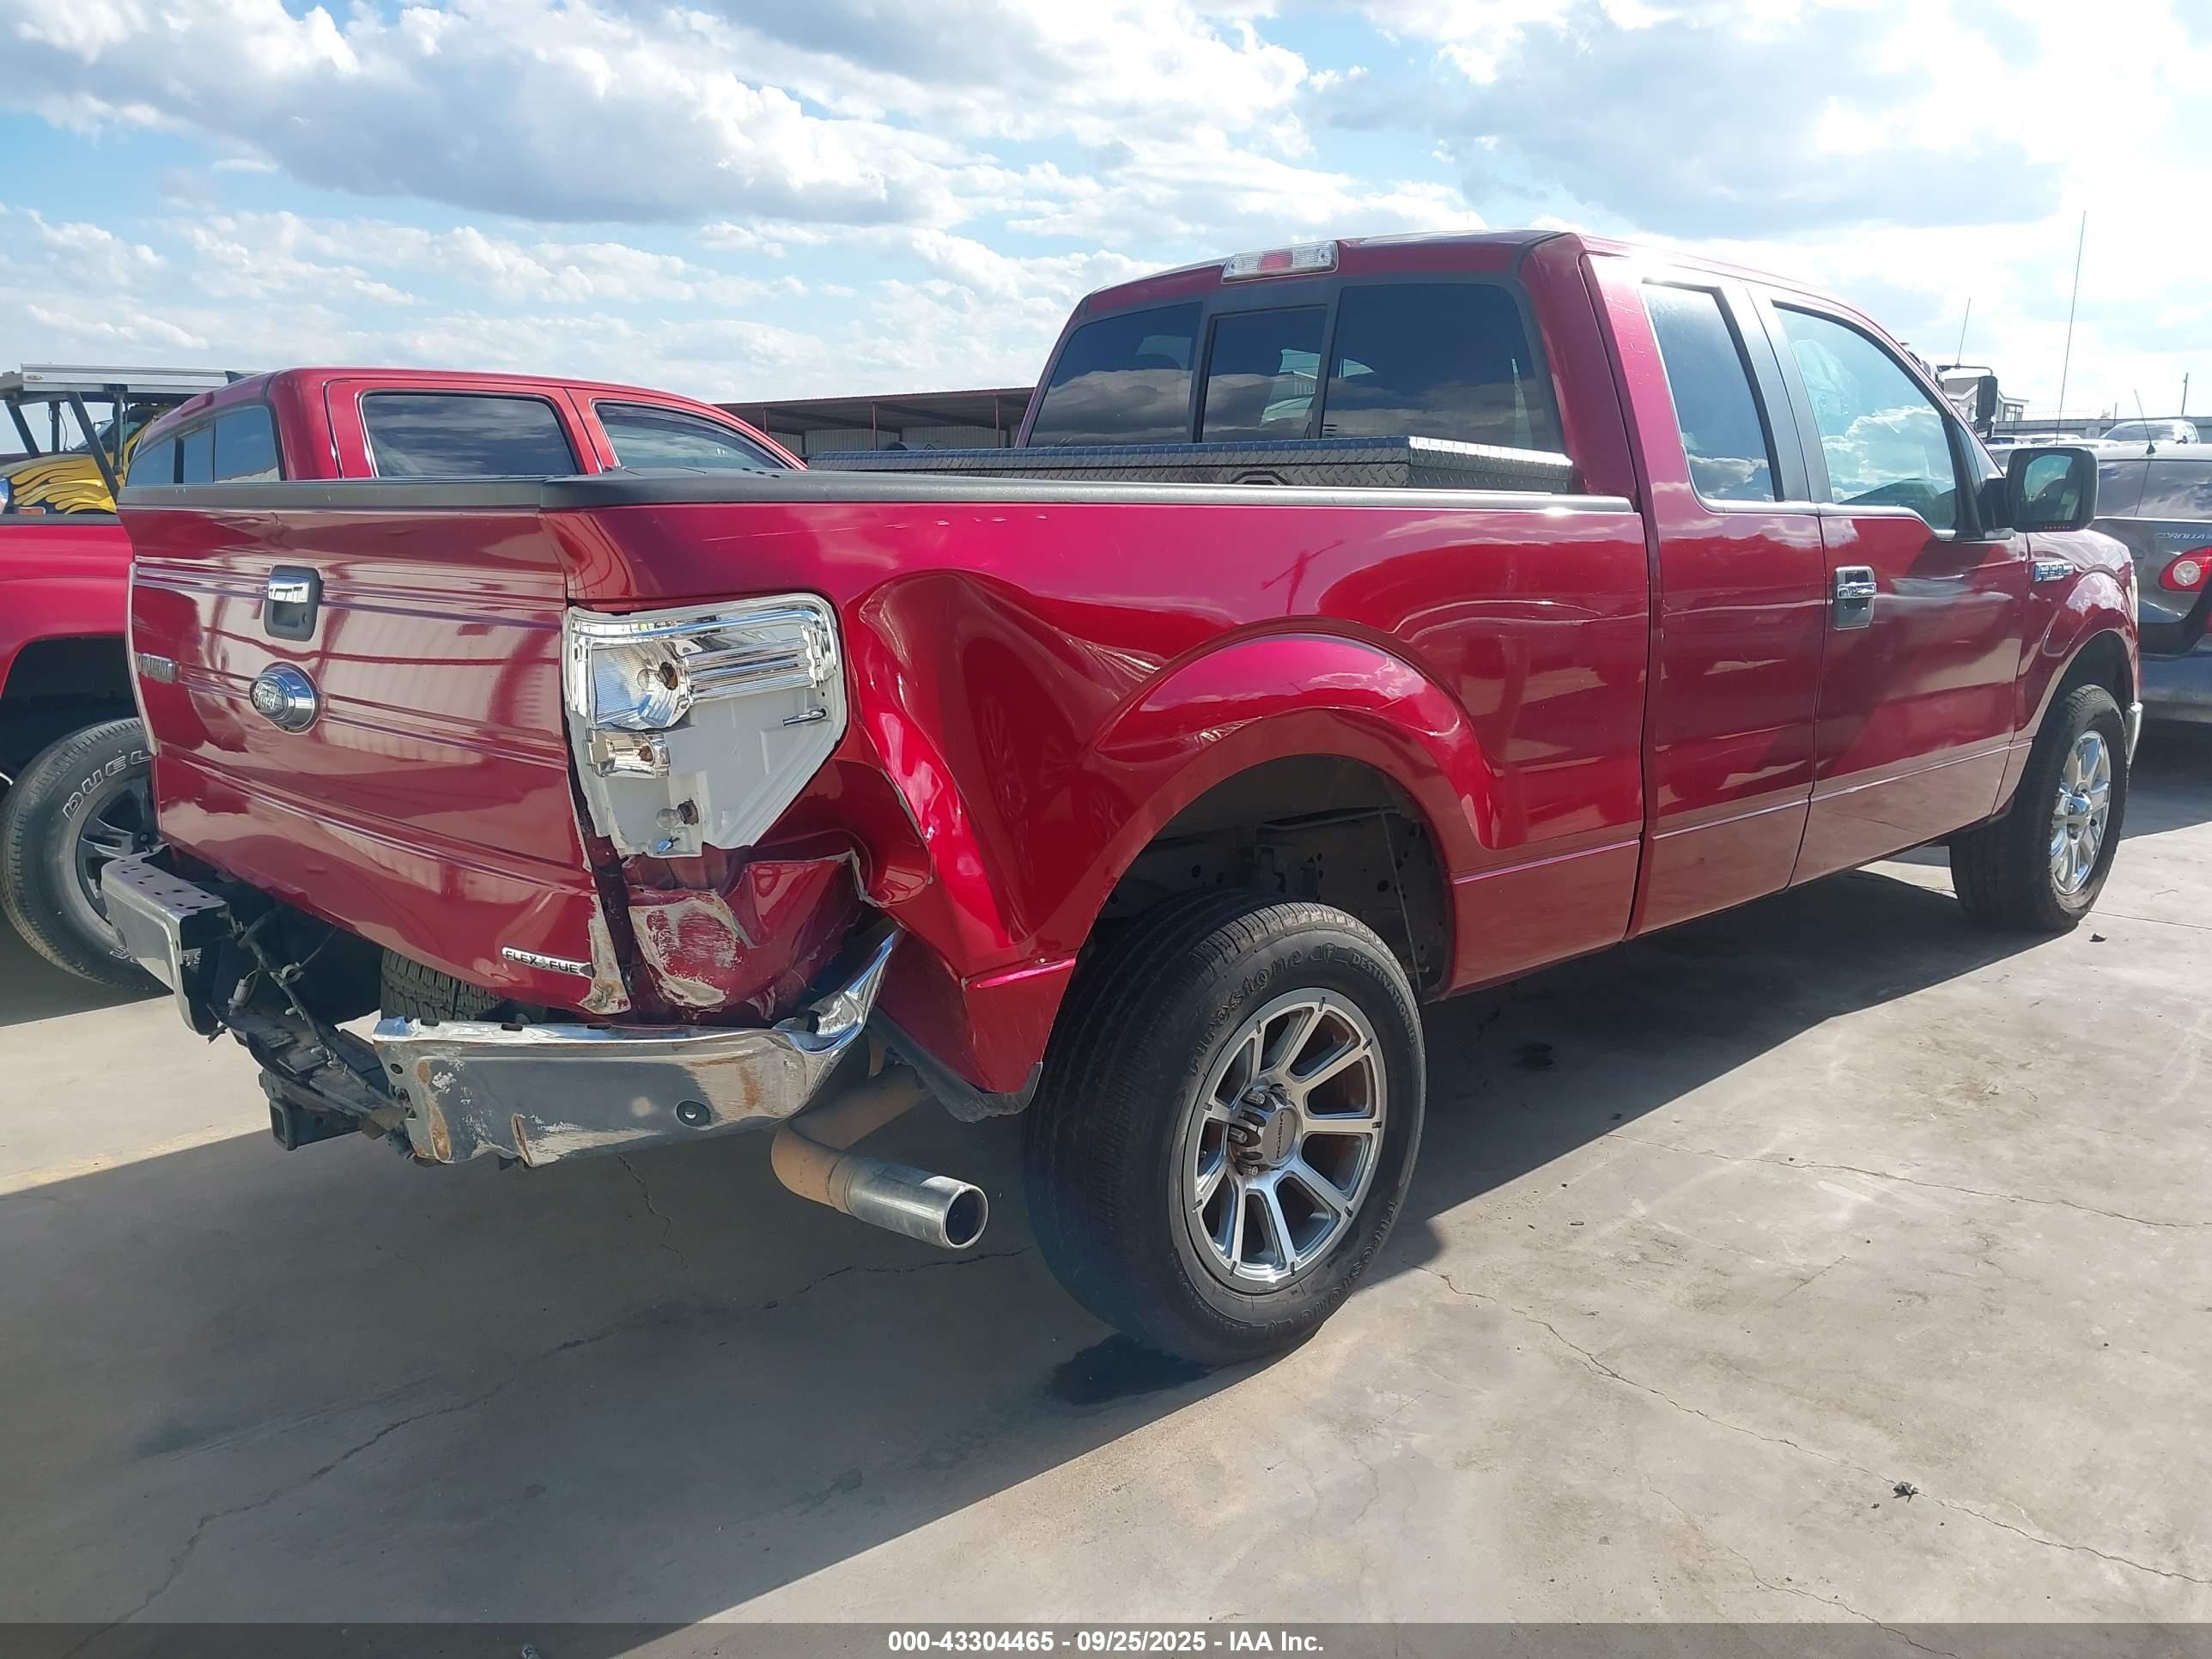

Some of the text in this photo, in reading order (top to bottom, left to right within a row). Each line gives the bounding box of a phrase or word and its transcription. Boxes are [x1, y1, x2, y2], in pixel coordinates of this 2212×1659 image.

[255, 682, 276, 711] Ford
[505, 950, 538, 965] FLEX
[1352, 952, 1410, 1028] DESTINATION
